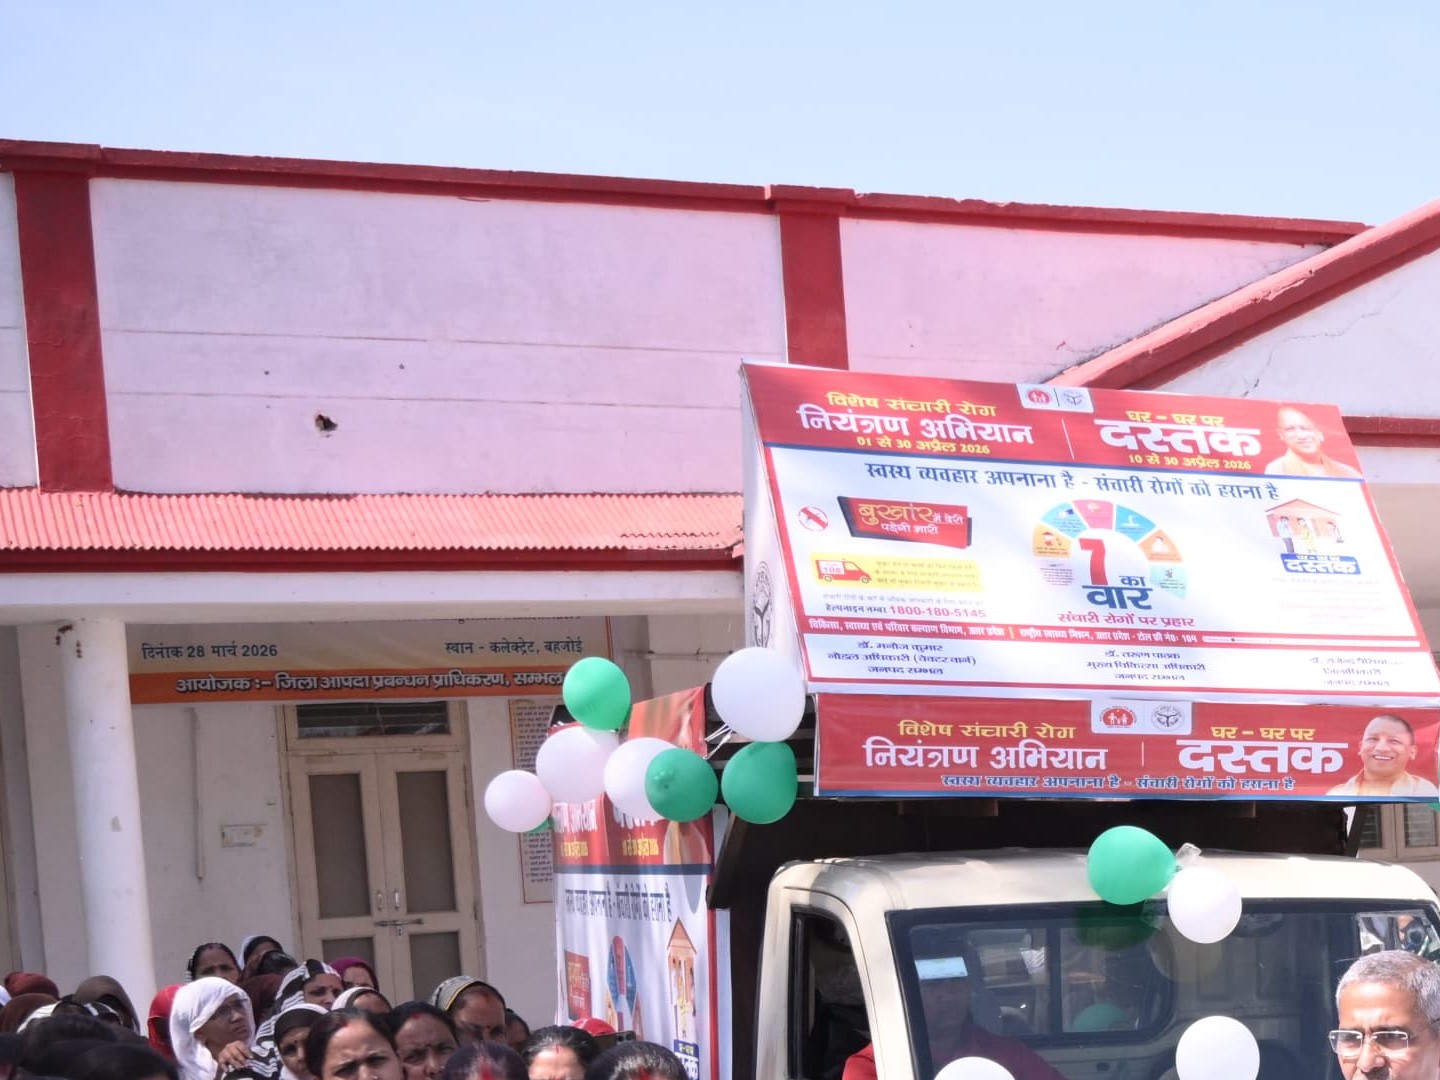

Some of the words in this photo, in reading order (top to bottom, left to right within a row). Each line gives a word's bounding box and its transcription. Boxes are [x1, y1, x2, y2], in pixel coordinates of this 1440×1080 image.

[825, 392, 879, 409] विशेष
[884, 396, 952, 414] संचारी
[956, 401, 996, 417] रोग
[796, 403, 910, 436] नियंत्रण
[918, 413, 1034, 444] अभियान
[1125, 410, 1151, 423] घर
[1171, 413, 1196, 426] घर
[1201, 415, 1224, 427] पर
[1094, 419, 1261, 457] दस्तक
[960, 443, 990, 454] 2026
[864, 463, 911, 480] स्वस्थ
[916, 465, 979, 485] व्यवहार
[984, 469, 1057, 489] अपनाना
[1061, 470, 1075, 489] है
[1094, 473, 1144, 494] संचारी
[1148, 477, 1183, 496] रोगों
[1190, 479, 1211, 497] को
[1218, 483, 1263, 500] हराना
[1266, 483, 1280, 500] है
[1119, 575, 1148, 587] का
[1082, 585, 1153, 610] वार
[889, 605, 986, 618] 1800-180-5145
[141, 642, 182, 659] दिनांक
[187, 646, 205, 658] 28
[210, 641, 238, 657] मार्च
[242, 645, 278, 657] 2026
[176, 673, 250, 692] आयोजक
[275, 672, 317, 690] जिला
[320, 675, 369, 690] आपदा
[897, 719, 953, 738] विशेष
[959, 721, 1028, 738] संचारी
[1033, 723, 1075, 738] रोग
[1211, 726, 1237, 739] घर
[1260, 728, 1285, 740] घर
[1289, 728, 1315, 741] पर
[862, 735, 979, 768] नियंत्रण
[989, 738, 1108, 770] अभियान
[1176, 739, 1348, 774] दस्तक
[1136, 775, 1178, 789] संचारी
[1217, 776, 1236, 789] को
[1283, 776, 1297, 791] है
